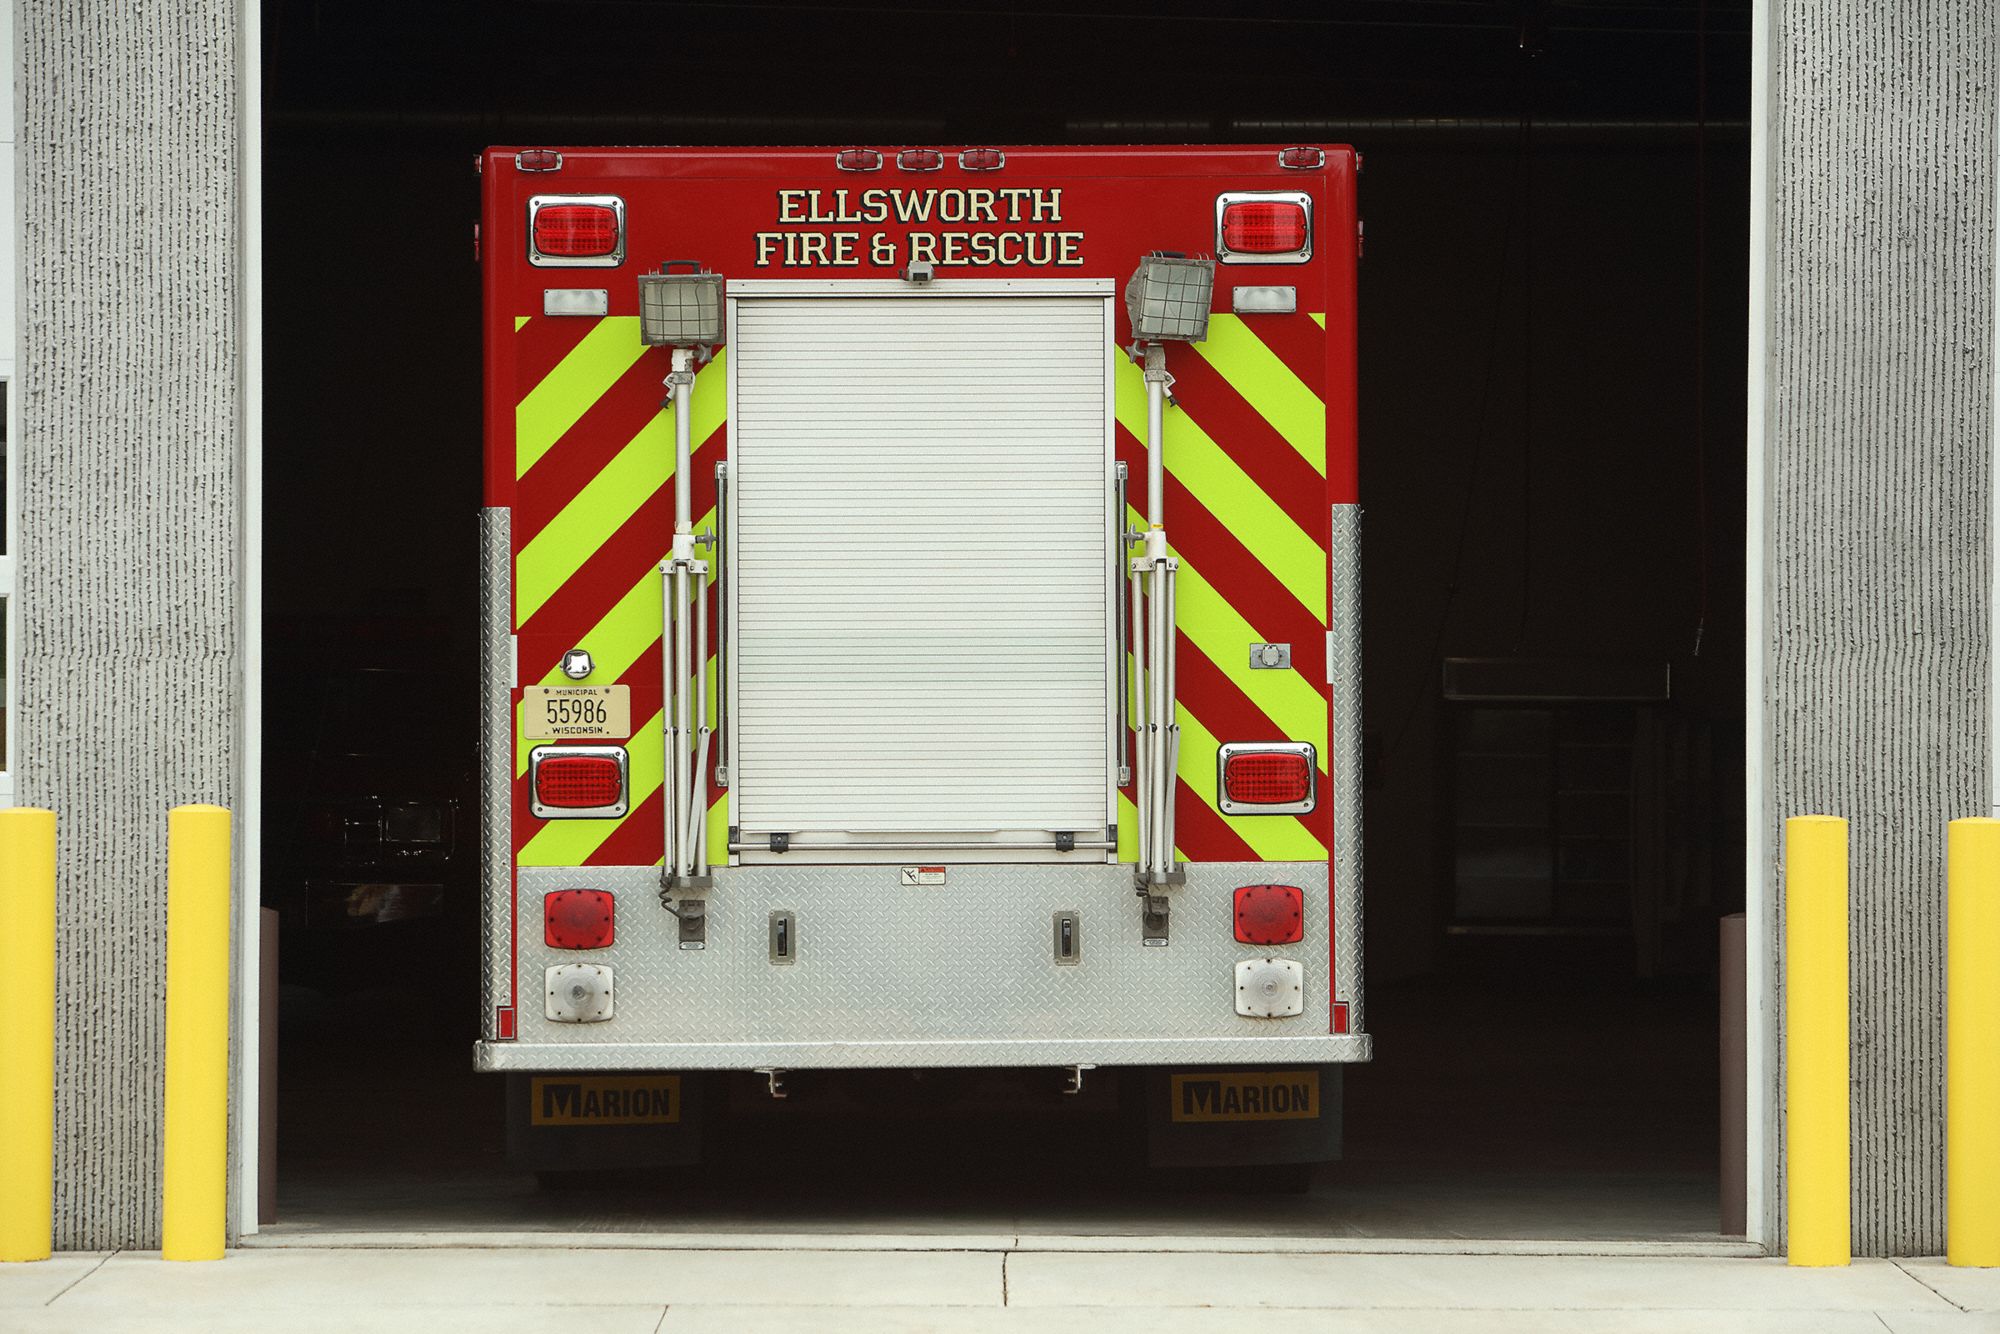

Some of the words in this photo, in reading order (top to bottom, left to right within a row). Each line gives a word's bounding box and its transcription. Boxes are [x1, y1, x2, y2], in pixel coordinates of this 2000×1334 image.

[777, 189, 1062, 223] ELLSWORTH
[754, 232, 859, 266] FIRE
[869, 232, 897, 266] &
[908, 232, 1084, 266] RESCUE
[547, 699, 607, 724] 55986
[552, 726, 603, 735] WISCONSIN
[543, 1083, 670, 1118] MARION
[1182, 1080, 1310, 1115] MARION
